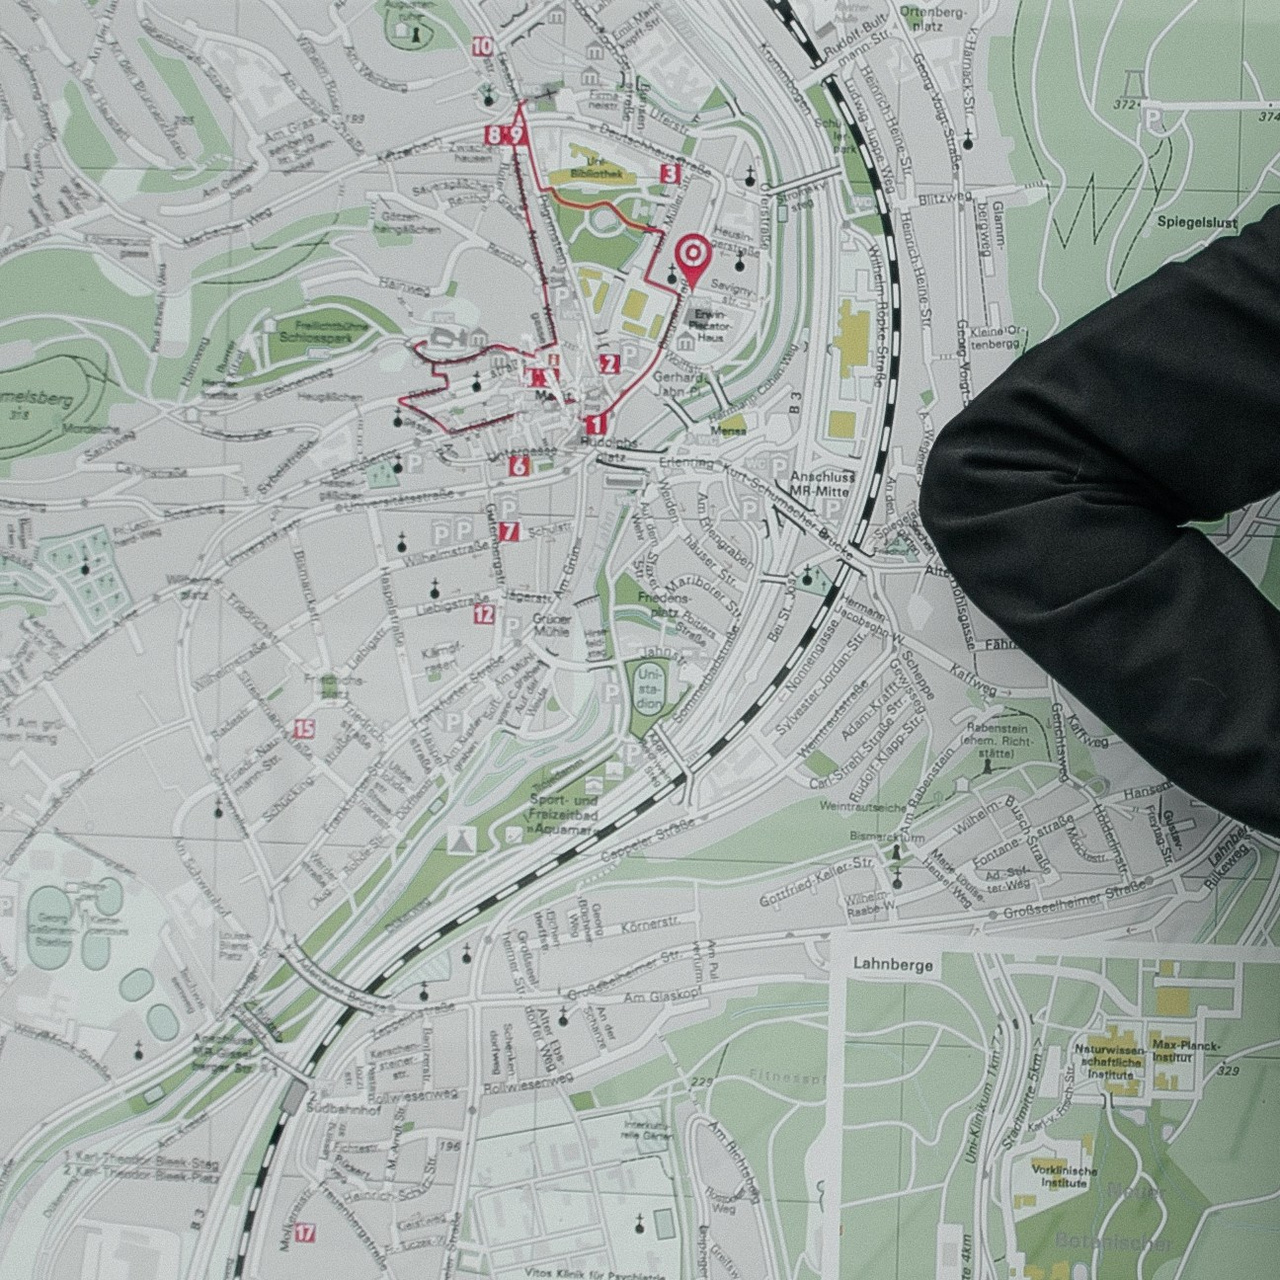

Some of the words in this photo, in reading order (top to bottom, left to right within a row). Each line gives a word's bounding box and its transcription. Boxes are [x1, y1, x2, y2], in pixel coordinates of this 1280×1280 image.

[900, 6, 968, 19] Ortenberg-
[912, 21, 944, 33] platz
[1113, 99, 1136, 111] 372
[1157, 215, 1239, 230] Spiegelslust
[710, 426, 747, 437] Mensa
[512, 458, 526, 475] 6
[790, 472, 856, 484] Anschluss
[789, 486, 850, 498] MR-Mitte
[503, 524, 516, 540] 7
[474, 607, 494, 624] 12
[966, 722, 1028, 735] Rabenstein
[849, 831, 926, 844] Bismarckturm
[853, 956, 934, 974] Lahnberge
[1075, 1044, 1147, 1056] Naturwissen-
[1152, 1039, 1221, 1052] Max-Planck-
[1153, 1052, 1193, 1063] Institut
[1088, 1069, 1134, 1081] Institute
[1216, 1066, 1240, 1077] 329
[1032, 1165, 1098, 1177] Vorklinische
[1041, 1178, 1087, 1189] Institute
